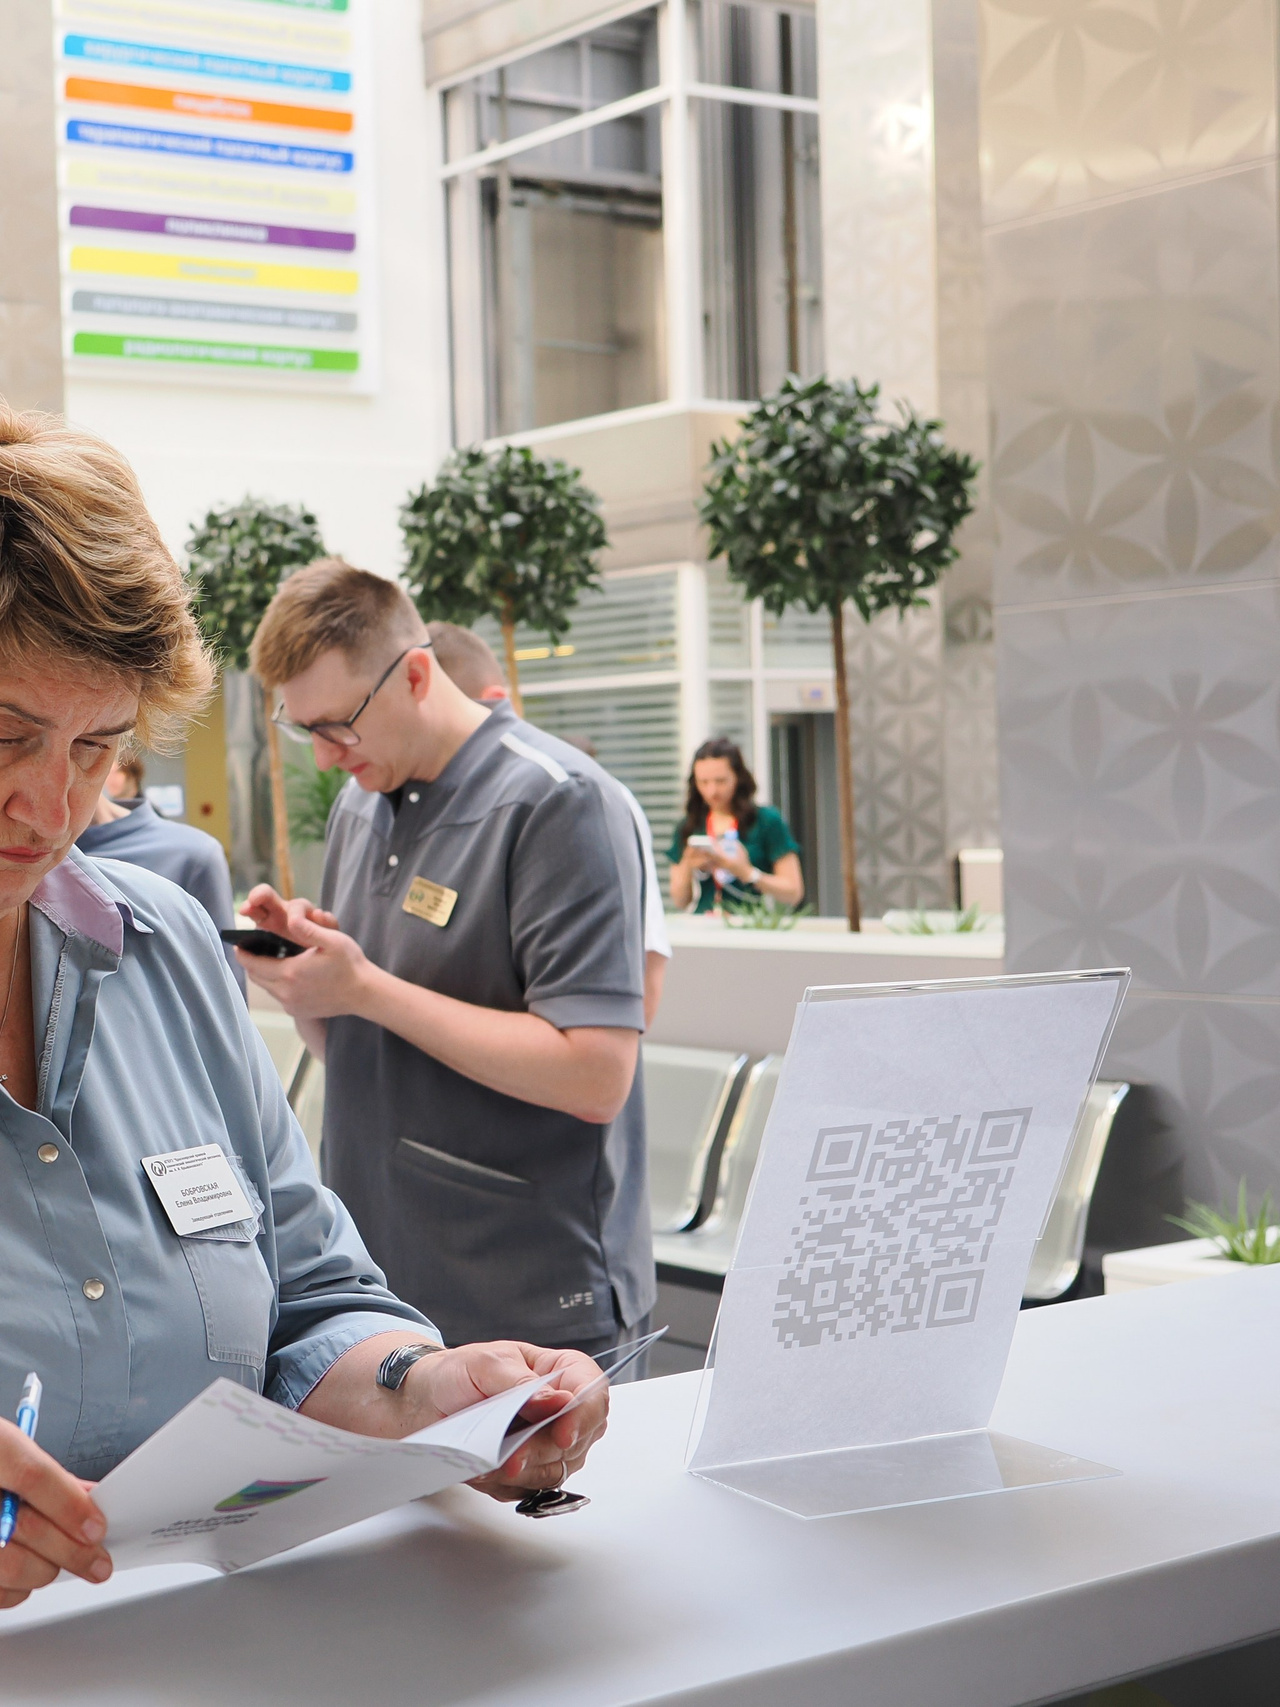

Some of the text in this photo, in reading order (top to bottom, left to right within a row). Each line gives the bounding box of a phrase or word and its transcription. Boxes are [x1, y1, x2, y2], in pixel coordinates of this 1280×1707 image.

[181, 1182, 219, 1197] БОБРОВСКАЯ
[175, 1190, 232, 1208] Елена Владимировна
